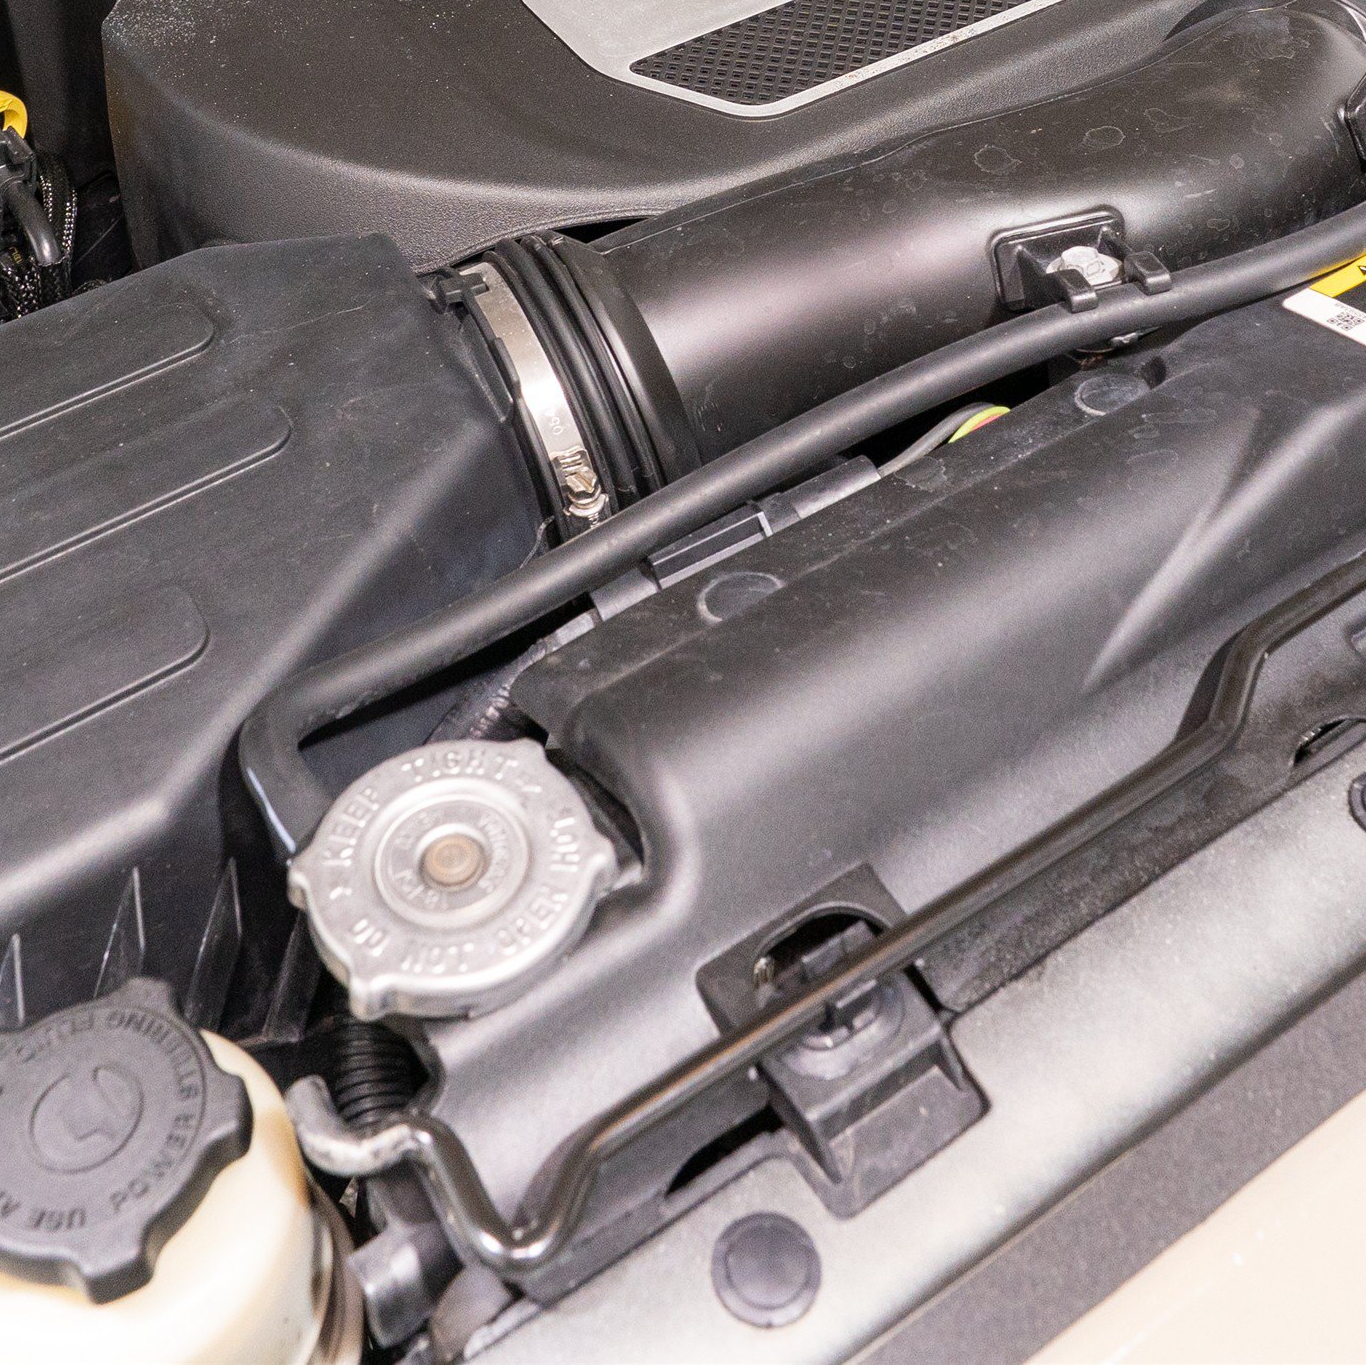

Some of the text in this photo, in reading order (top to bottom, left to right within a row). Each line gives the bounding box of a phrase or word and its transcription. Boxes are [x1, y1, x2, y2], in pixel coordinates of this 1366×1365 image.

[322, 788, 380, 868] KEEP
[401, 750, 520, 783] TIGHT
[401, 942, 476, 973] NOT
[497, 885, 569, 956] OPEN
[549, 816, 581, 873] HOT
[106, 1009, 200, 1102] STEERING
[109, 1112, 196, 1214] POWER
[26, 1206, 88, 1231] USE
